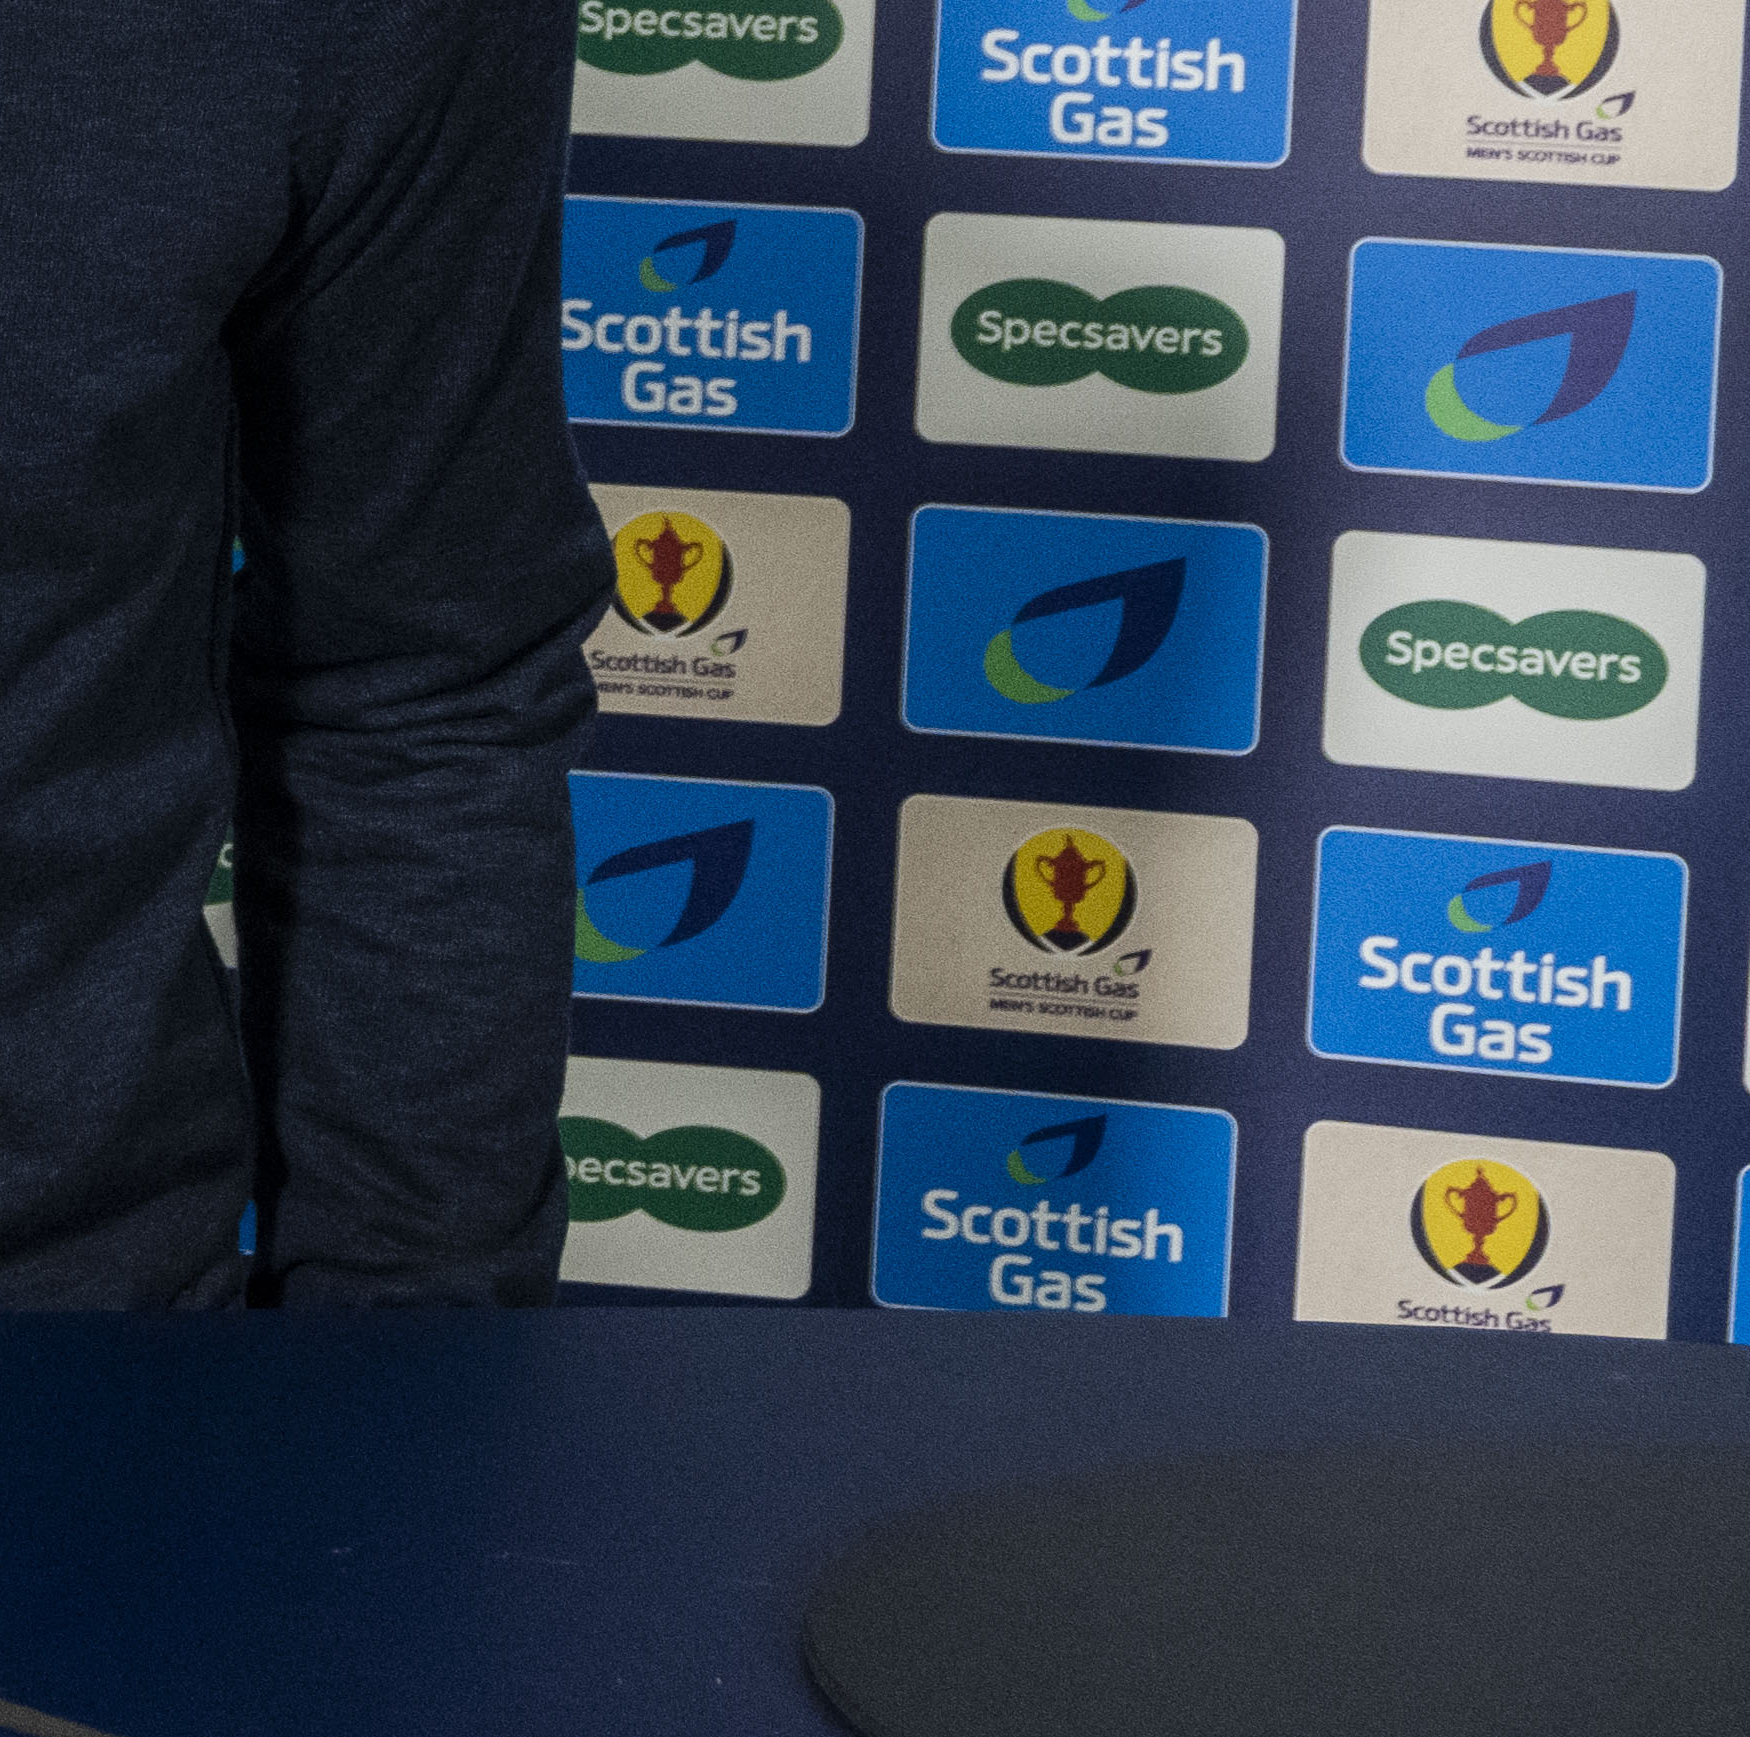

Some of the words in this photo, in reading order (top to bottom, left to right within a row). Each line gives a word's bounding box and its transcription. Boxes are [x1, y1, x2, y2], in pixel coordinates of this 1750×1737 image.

[580, 0, 819, 44] Specsavers
[983, 29, 1245, 92] Scottish
[1050, 91, 1168, 147] Gas
[1467, 116, 1569, 138] Scottish
[1576, 122, 1622, 142] Gas
[561, 299, 811, 362] Scottish
[977, 310, 1223, 357] Specsavers
[622, 361, 737, 416] Gas
[592, 651, 687, 673] Scottish
[694, 658, 736, 678] Gas
[1387, 630, 1641, 683] Specsavers
[991, 969, 1088, 993] Scottish
[1095, 977, 1139, 998] Gas
[1357, 935, 1633, 1010] Scottish
[1430, 1002, 1552, 1063] Gas
[923, 1189, 1183, 1263] Scottish
[990, 1254, 1106, 1314] Gas
[1398, 1301, 1498, 1324] Scottish
[1506, 1311, 1551, 1332] Gas
